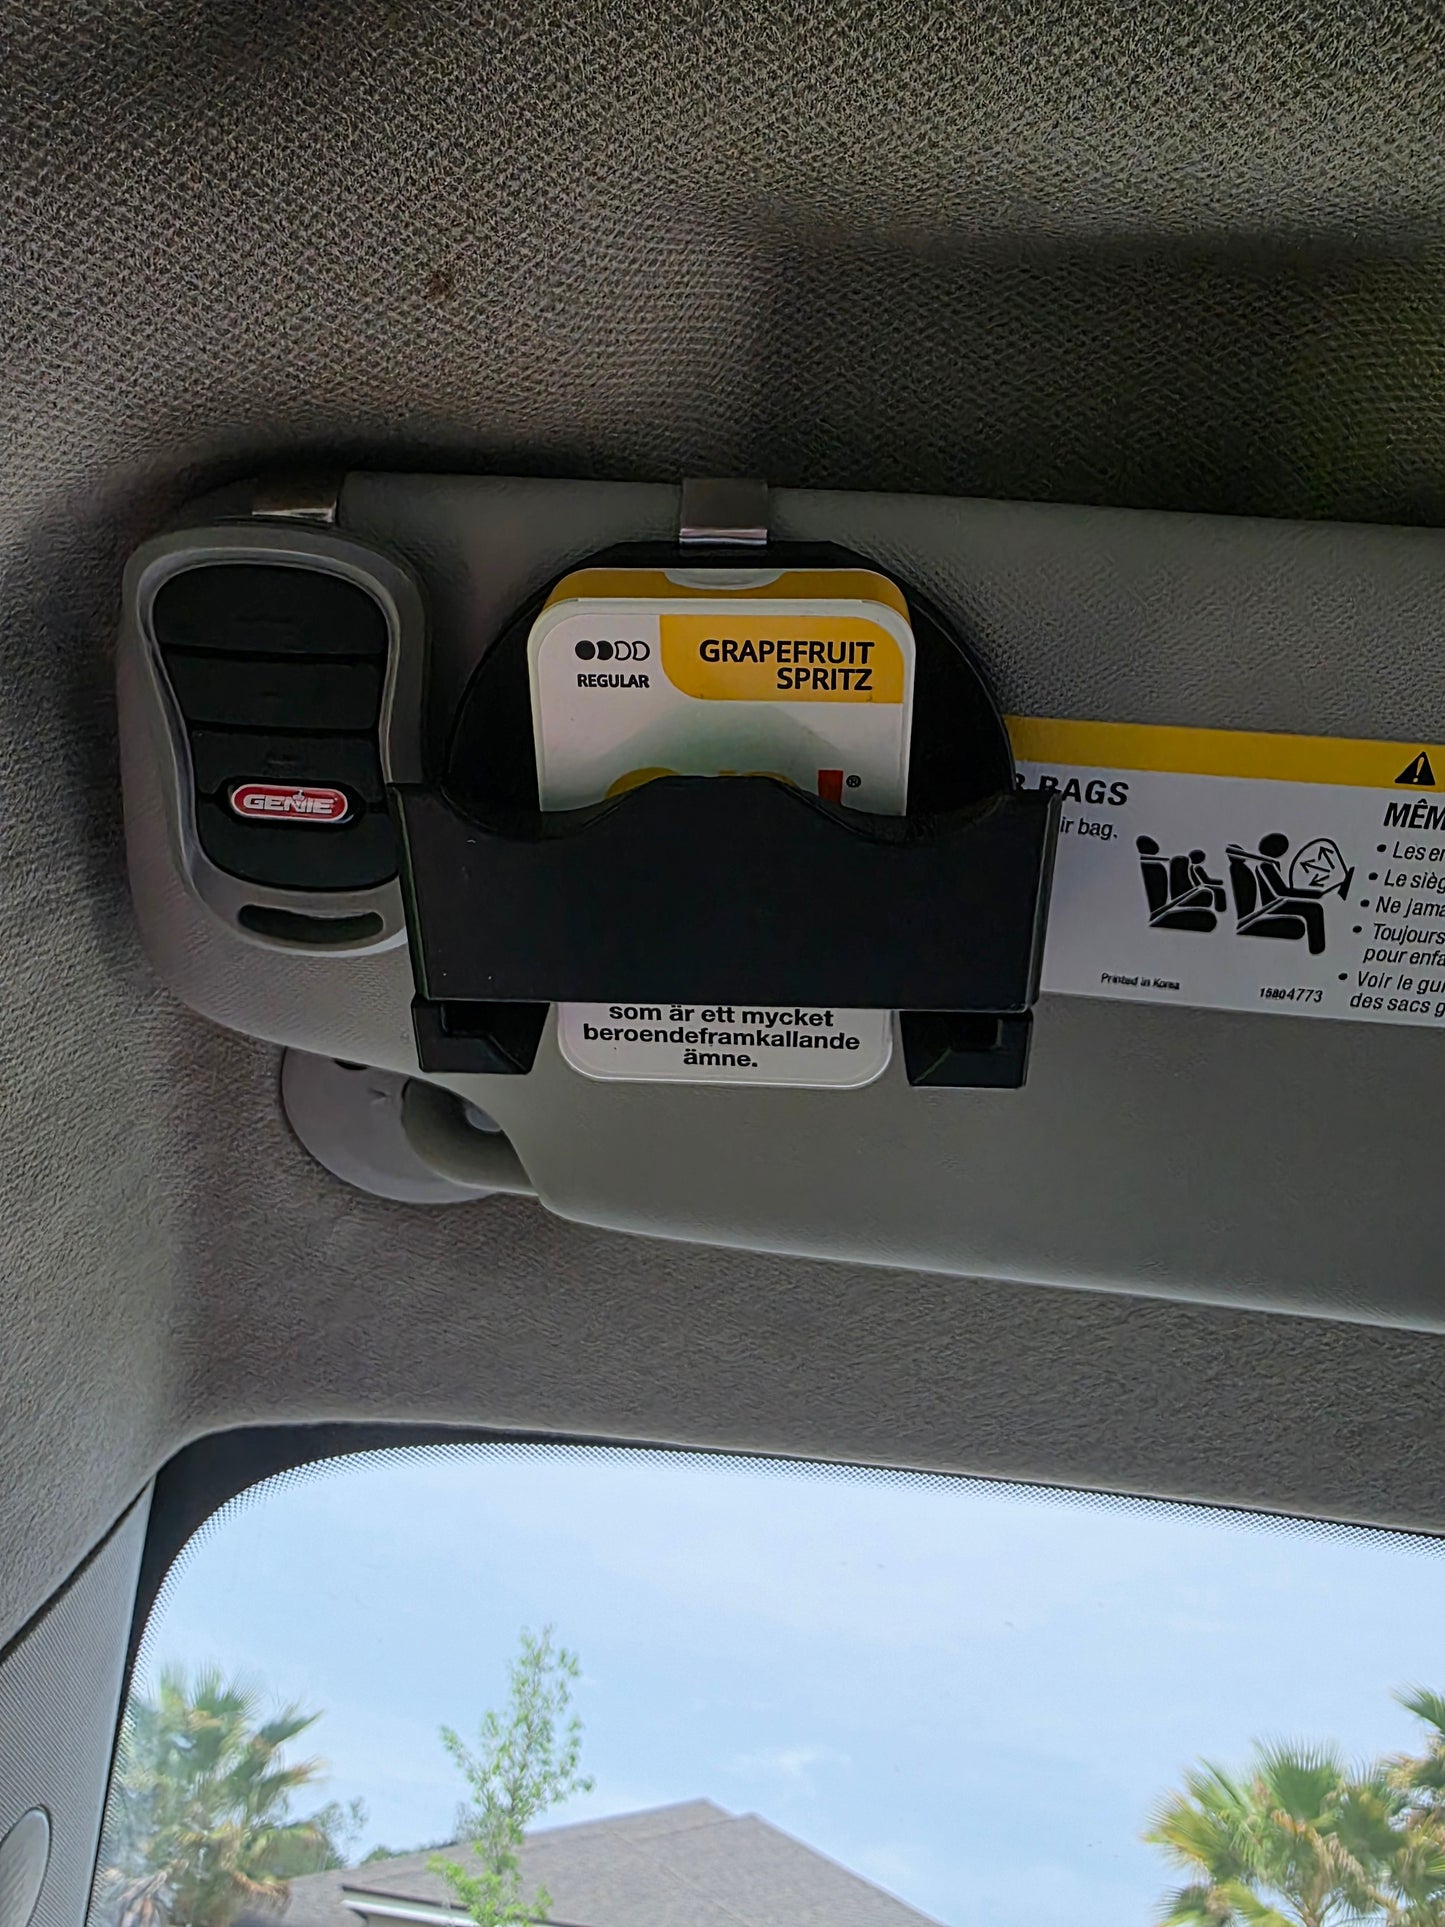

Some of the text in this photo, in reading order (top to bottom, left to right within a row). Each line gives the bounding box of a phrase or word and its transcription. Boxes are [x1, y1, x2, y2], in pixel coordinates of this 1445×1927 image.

[699, 639, 876, 666] GRAPEFRUIT
[577, 674, 650, 689] REGULAR
[776, 668, 873, 691] SPRITZ
[1039, 775, 1130, 806] BAGS
[243, 793, 335, 815] GENIE
[1060, 816, 1119, 841] ir bag.
[1392, 841, 1427, 861] Les
[1384, 868, 1408, 888] Le
[1375, 895, 1401, 914] Ne
[1373, 922, 1445, 946] Toujours
[1362, 948, 1408, 964] pour
[1101, 973, 1180, 991] Printed in Korea
[1358, 970, 1393, 989] Voir
[1396, 974, 1413, 991] le
[1350, 993, 1384, 1010] des
[1387, 997, 1431, 1014] sacs
[608, 1005, 834, 1029] som är ett mycket
[583, 1023, 861, 1051] beroendeframkallande
[683, 1049, 759, 1069] ämne.
